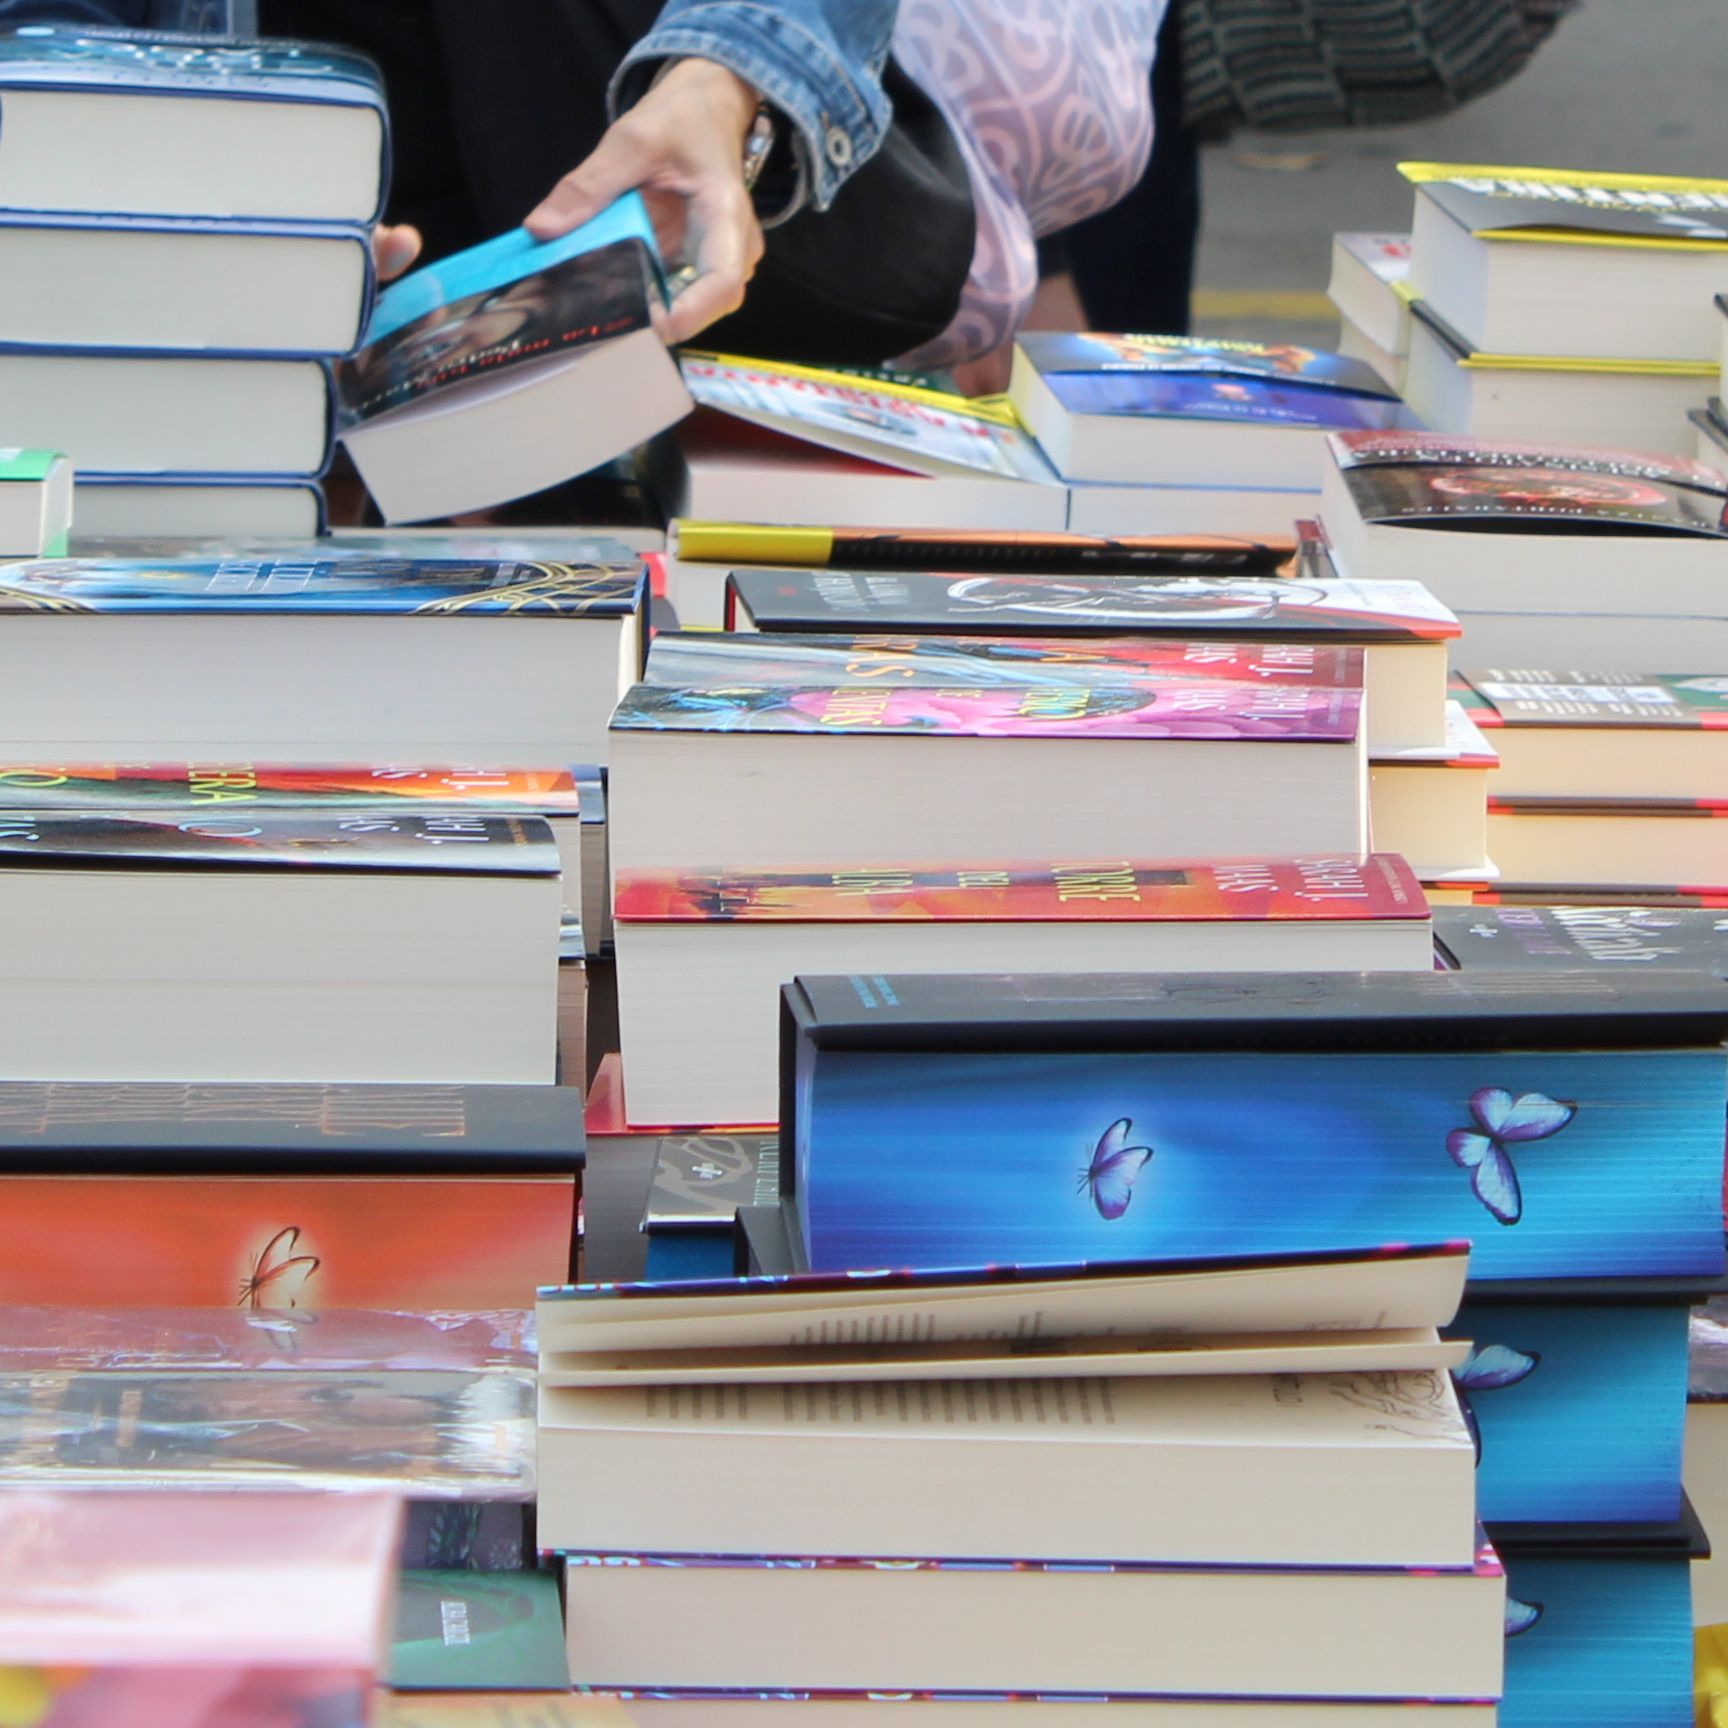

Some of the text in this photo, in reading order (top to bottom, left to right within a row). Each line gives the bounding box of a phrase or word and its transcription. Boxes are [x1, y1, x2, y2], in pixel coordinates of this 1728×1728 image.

[830, 866, 914, 897] ALBA
[954, 870, 1011, 888] DEL
[1048, 860, 1142, 903] TORRE
[1291, 858, 1366, 888] SARAH
